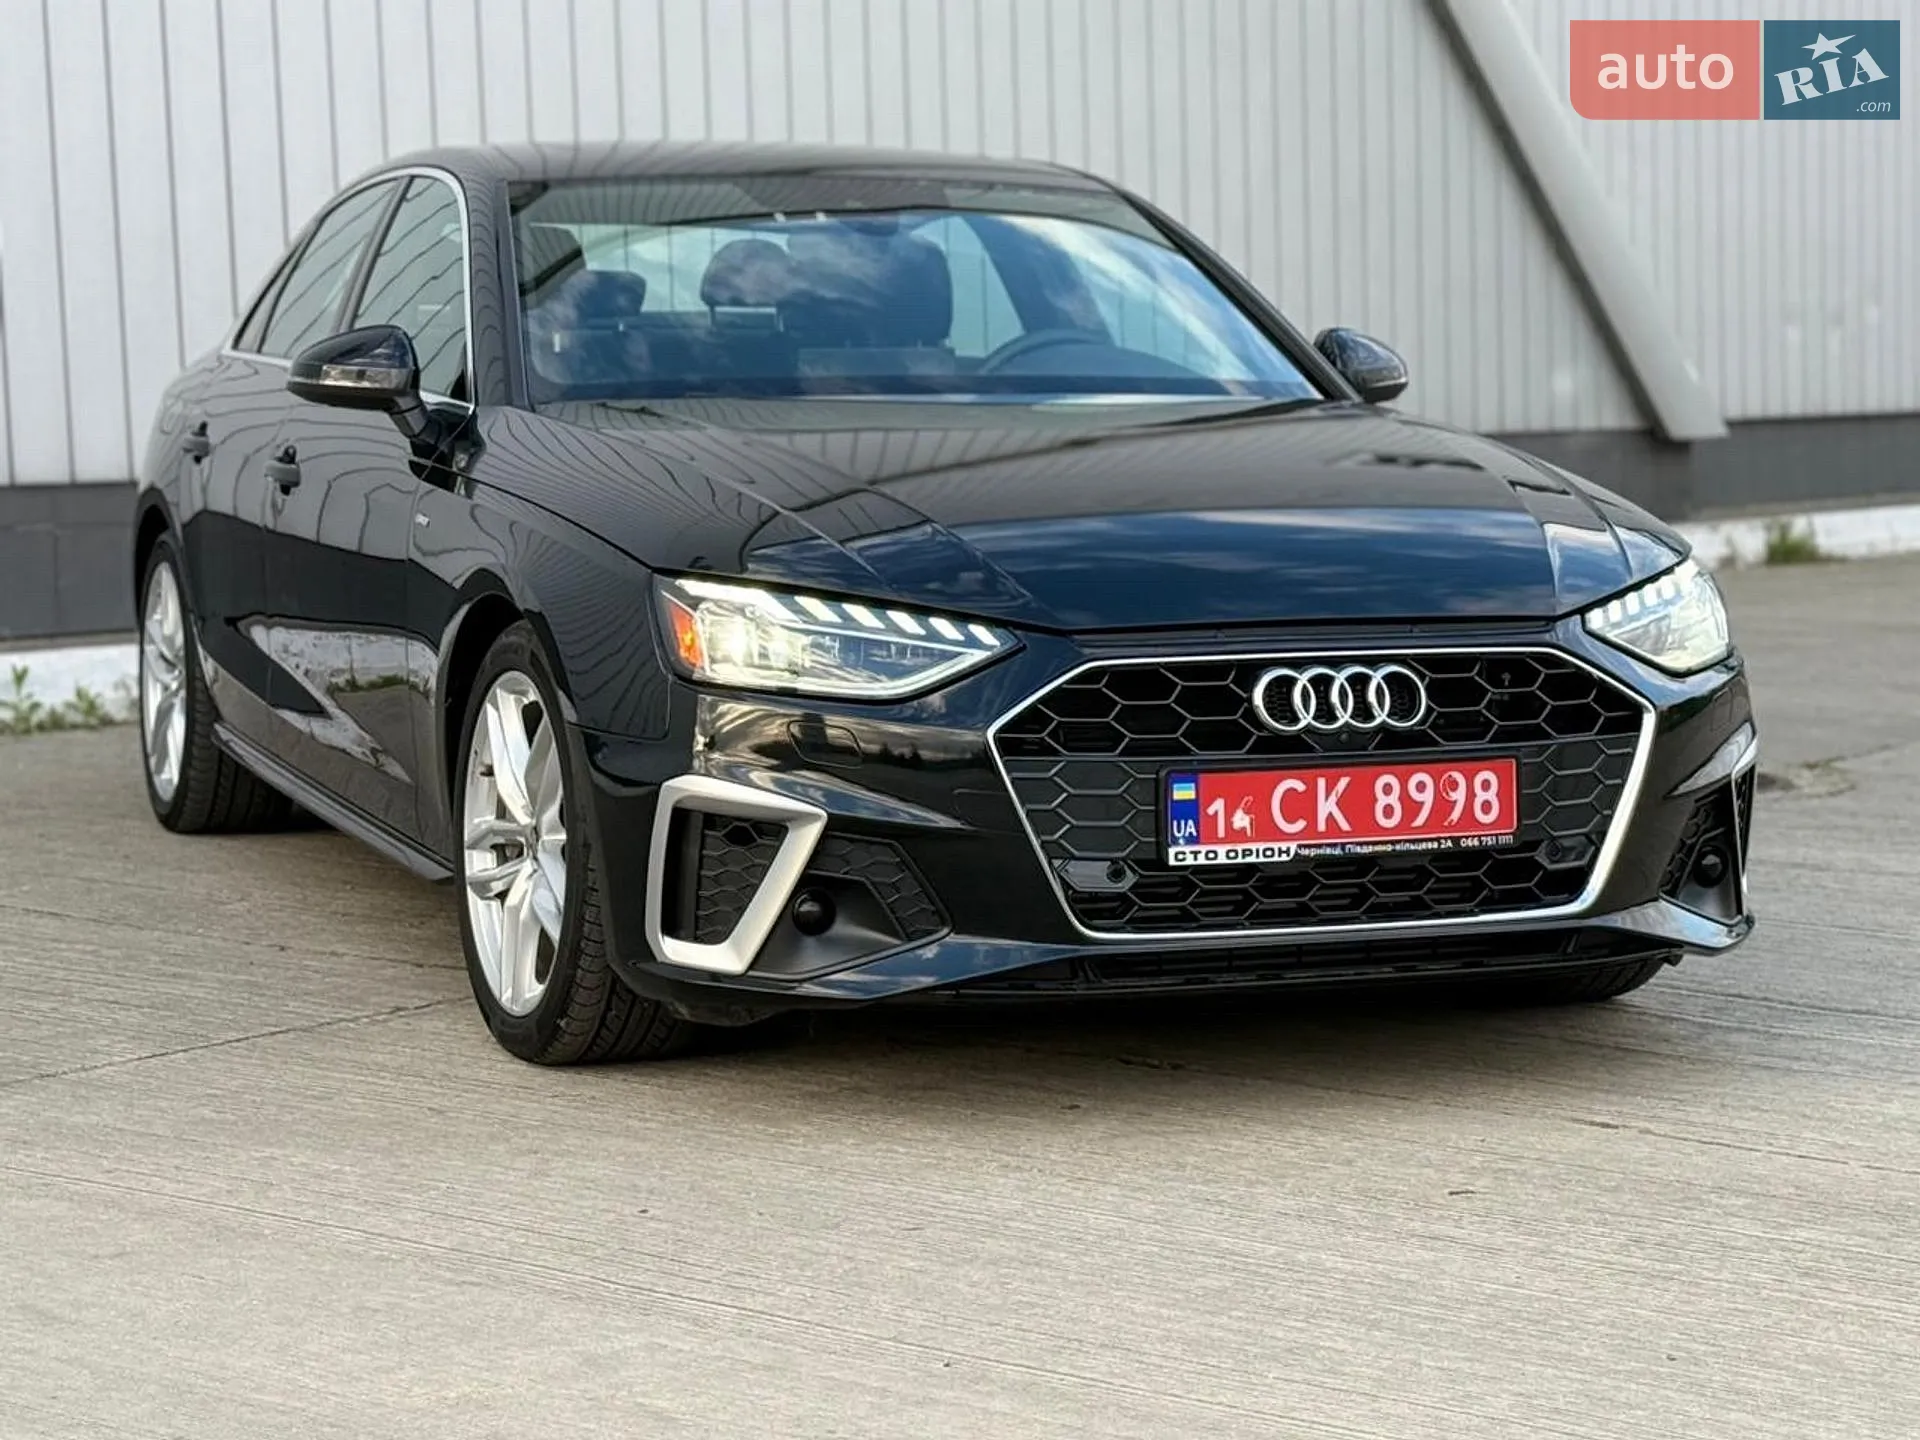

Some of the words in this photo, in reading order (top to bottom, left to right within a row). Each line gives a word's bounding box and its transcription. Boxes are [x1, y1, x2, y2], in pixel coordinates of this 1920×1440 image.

[1270, 775, 1353, 834] CK
[1373, 769, 1501, 829] 8998
[1173, 820, 1197, 837] UA
[1174, 849, 1219, 863] СТО
[1225, 846, 1292, 861] ОРІОН
